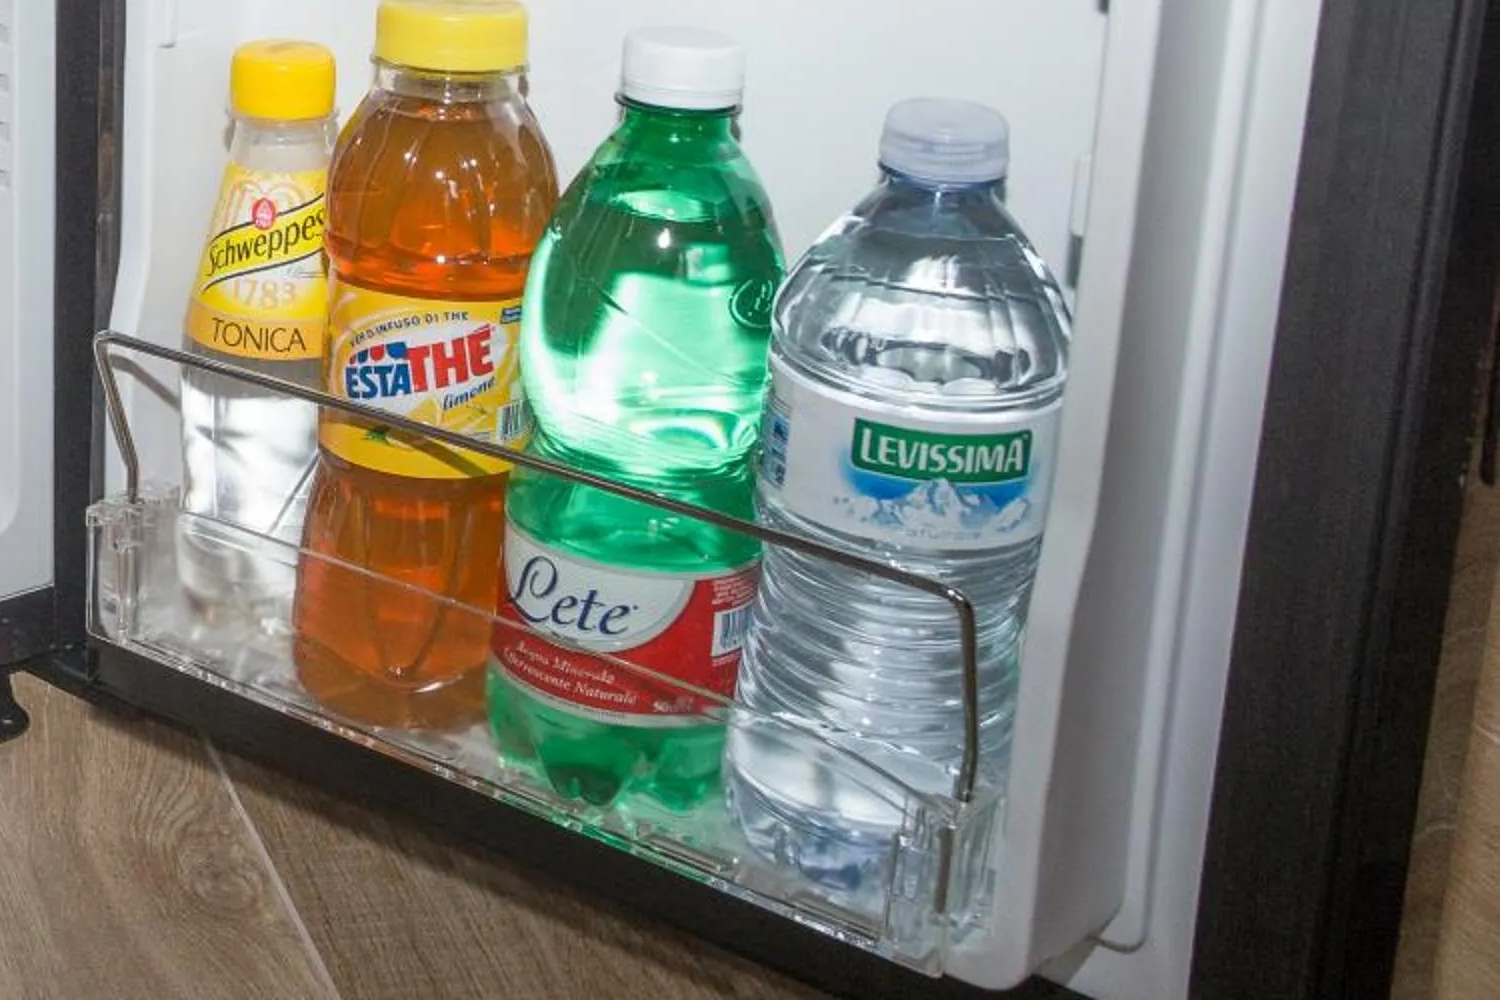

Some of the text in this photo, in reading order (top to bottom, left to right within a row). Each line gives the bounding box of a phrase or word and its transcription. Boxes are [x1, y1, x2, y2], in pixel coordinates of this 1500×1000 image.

[234, 278, 297, 310] 1783
[211, 317, 307, 353] TONICA
[376, 316, 420, 336] INFUSO
[425, 312, 440, 325] DI
[860, 427, 1023, 474] LEVISSIMA
[509, 556, 630, 635] Lete
[553, 655, 615, 685] Minerale
[575, 681, 637, 705] Naturale
